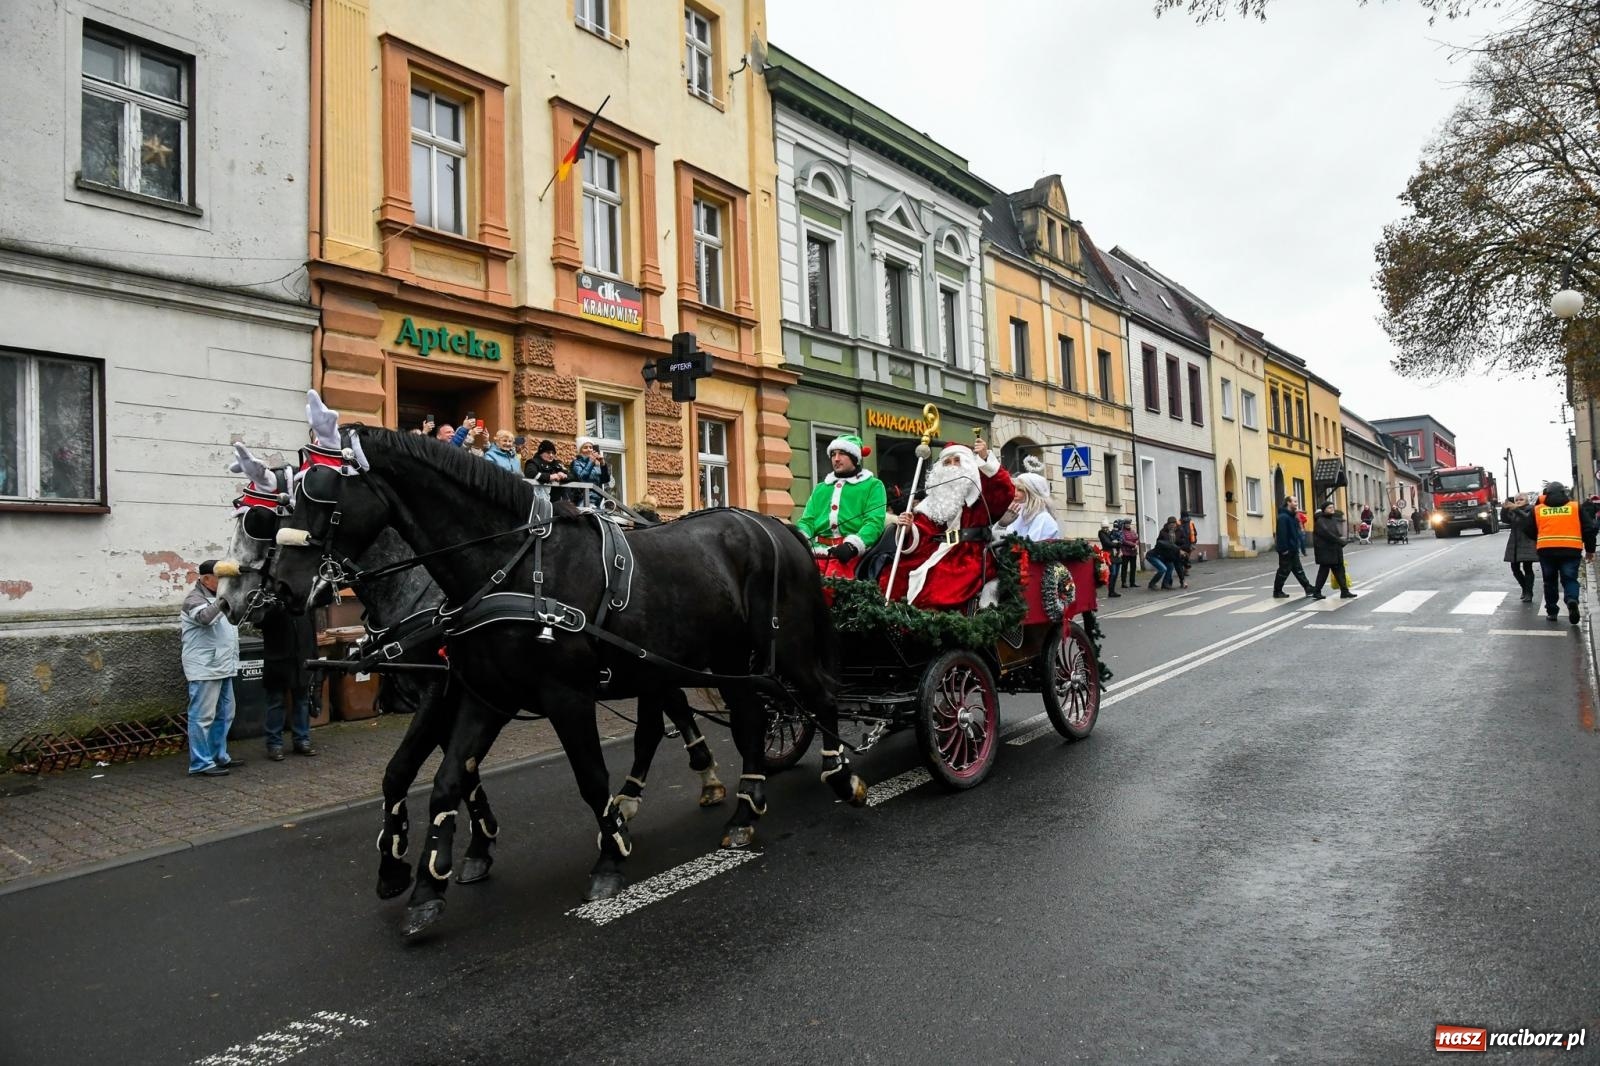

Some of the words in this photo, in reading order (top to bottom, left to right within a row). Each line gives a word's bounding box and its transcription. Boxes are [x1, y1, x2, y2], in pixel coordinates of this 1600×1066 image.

[583, 298, 638, 324] KRANOWITZ
[395, 316, 501, 360] Apteka
[670, 361, 692, 371] APTEKA
